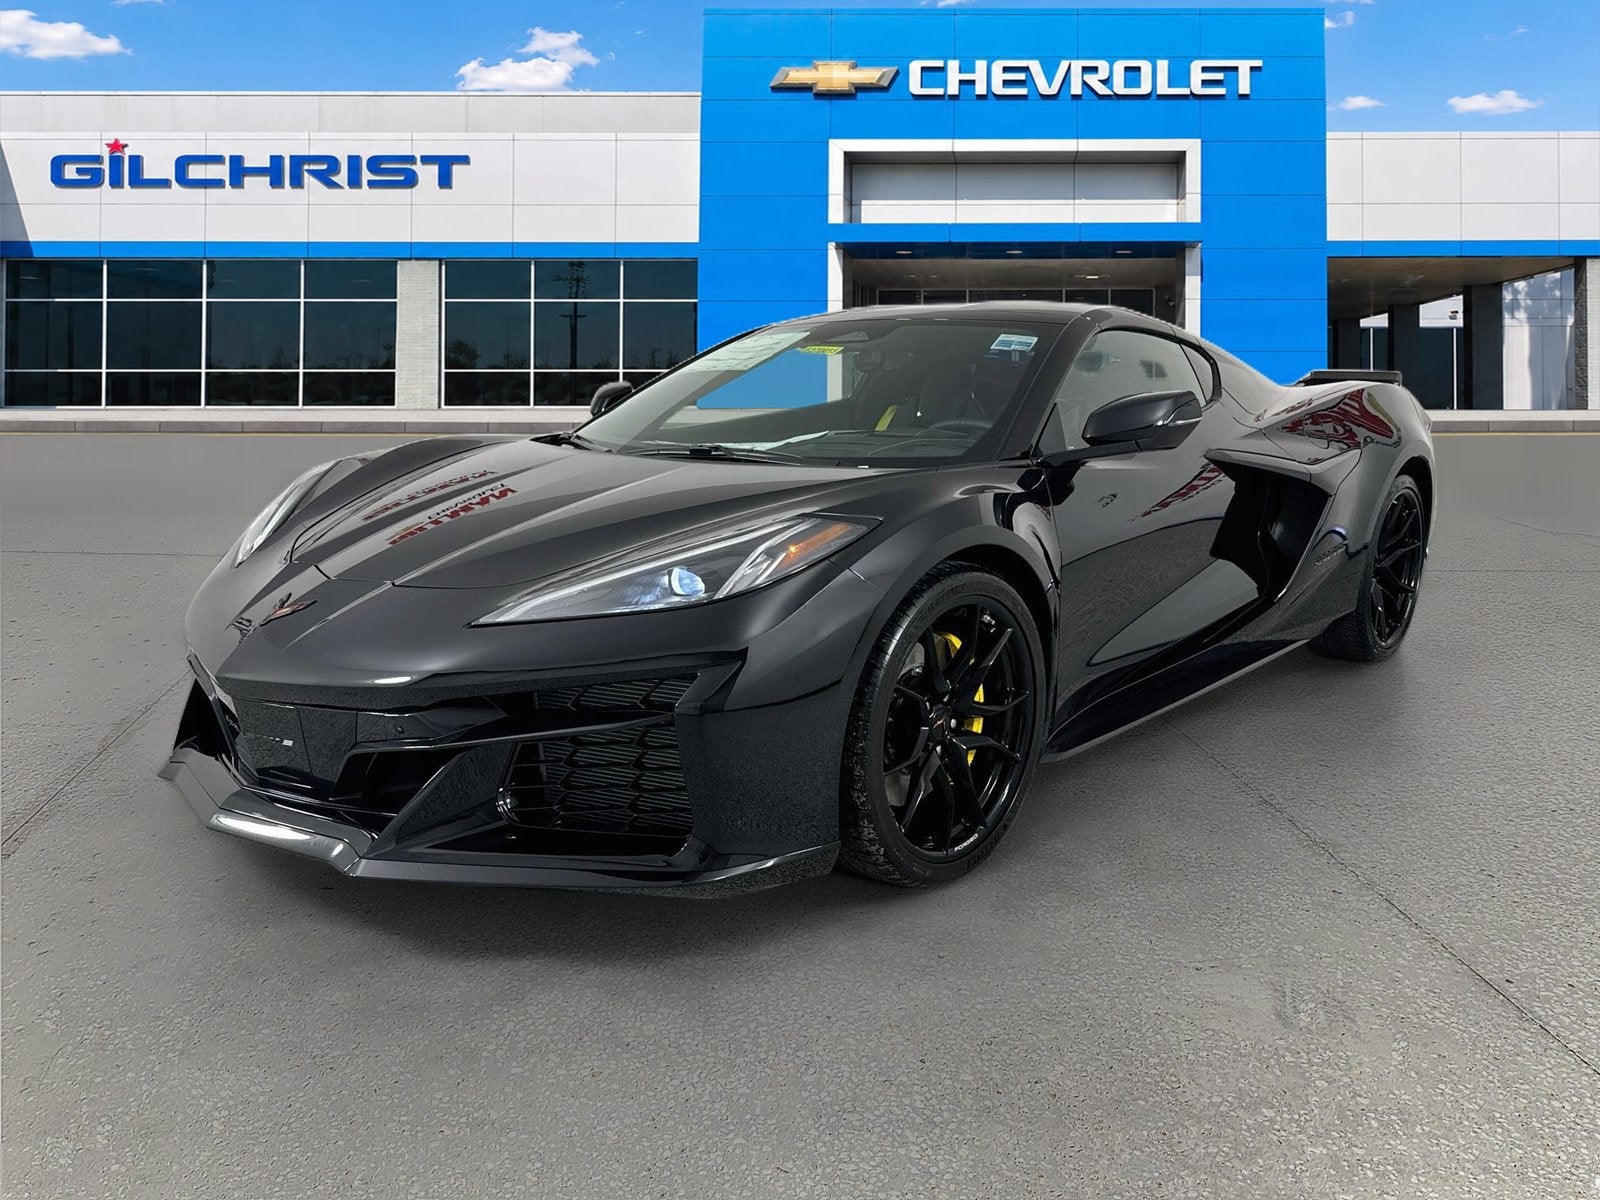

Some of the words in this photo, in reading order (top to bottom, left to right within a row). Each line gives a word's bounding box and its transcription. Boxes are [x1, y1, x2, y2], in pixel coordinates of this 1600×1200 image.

[909, 60, 1263, 96] CHEVROLET
[50, 153, 471, 189] GILCHRIST
[954, 833, 978, 852] FORGED
